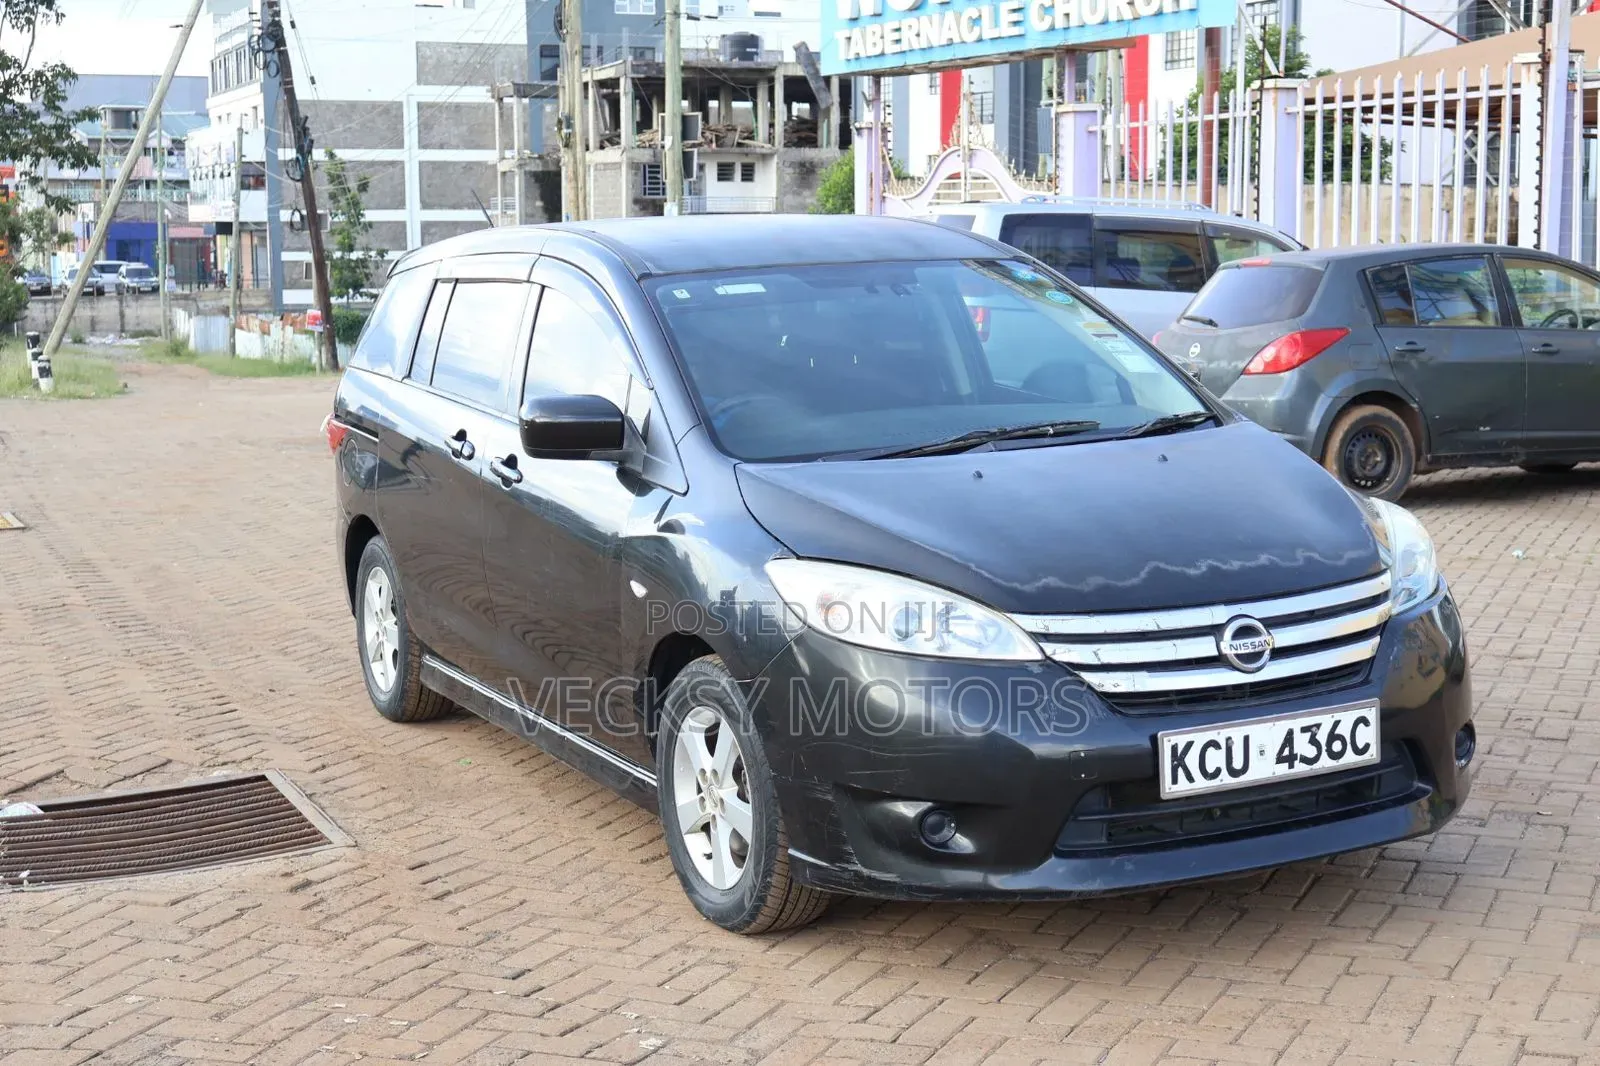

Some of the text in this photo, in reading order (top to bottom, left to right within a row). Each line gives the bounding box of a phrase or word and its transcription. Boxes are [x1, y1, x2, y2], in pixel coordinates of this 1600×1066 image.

[834, 3, 1025, 61] TABERNACLE
[1030, 0, 1198, 32] CHUR
[1229, 638, 1272, 652] NISSAN
[1170, 715, 1371, 785] KCU 436C
